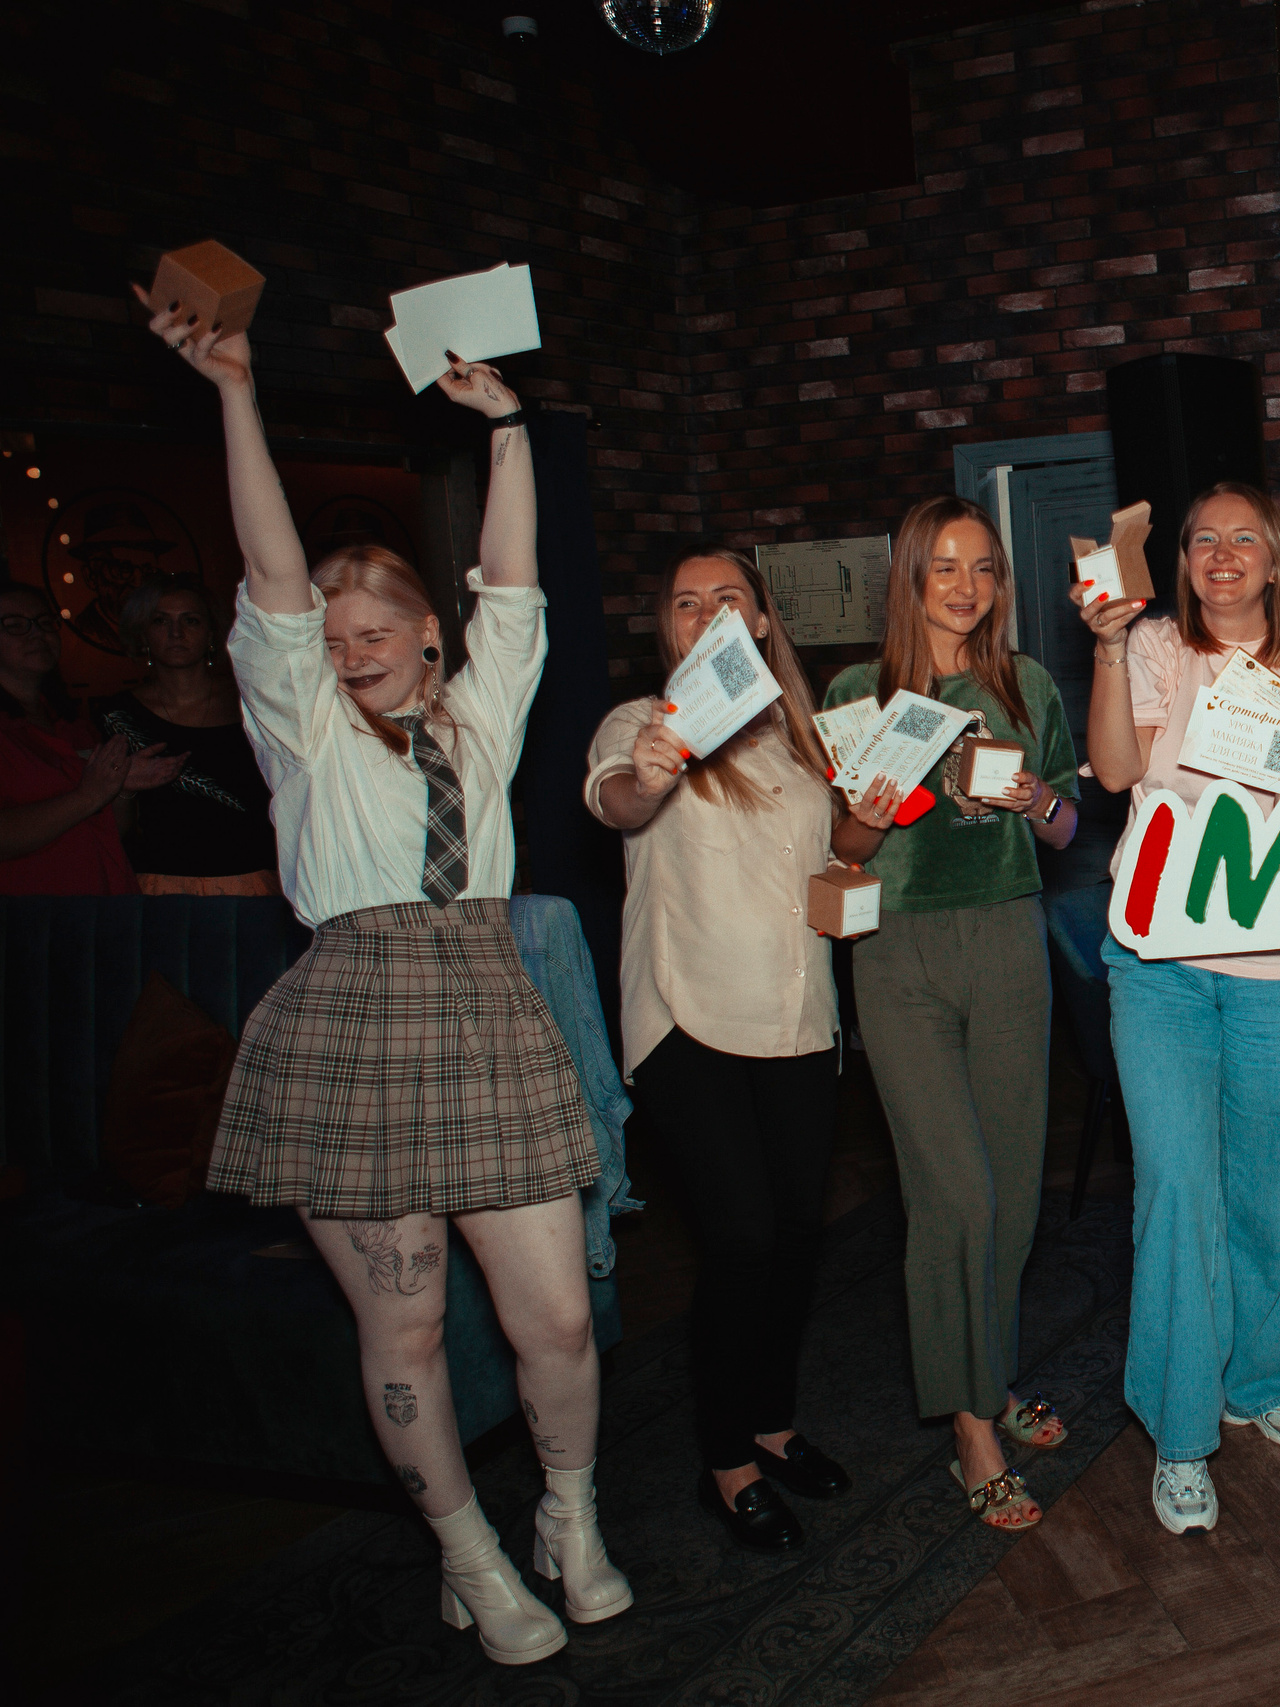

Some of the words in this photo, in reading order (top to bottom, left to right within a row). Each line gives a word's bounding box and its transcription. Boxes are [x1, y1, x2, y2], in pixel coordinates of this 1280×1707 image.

[1229, 719, 1254, 735] УРОК
[851, 710, 899, 771] Сертификат
[1210, 729, 1263, 753] МАКИЯЖА
[1207, 743, 1230, 760] ДЛЯ
[1228, 747, 1258, 766] СЕБЯ
